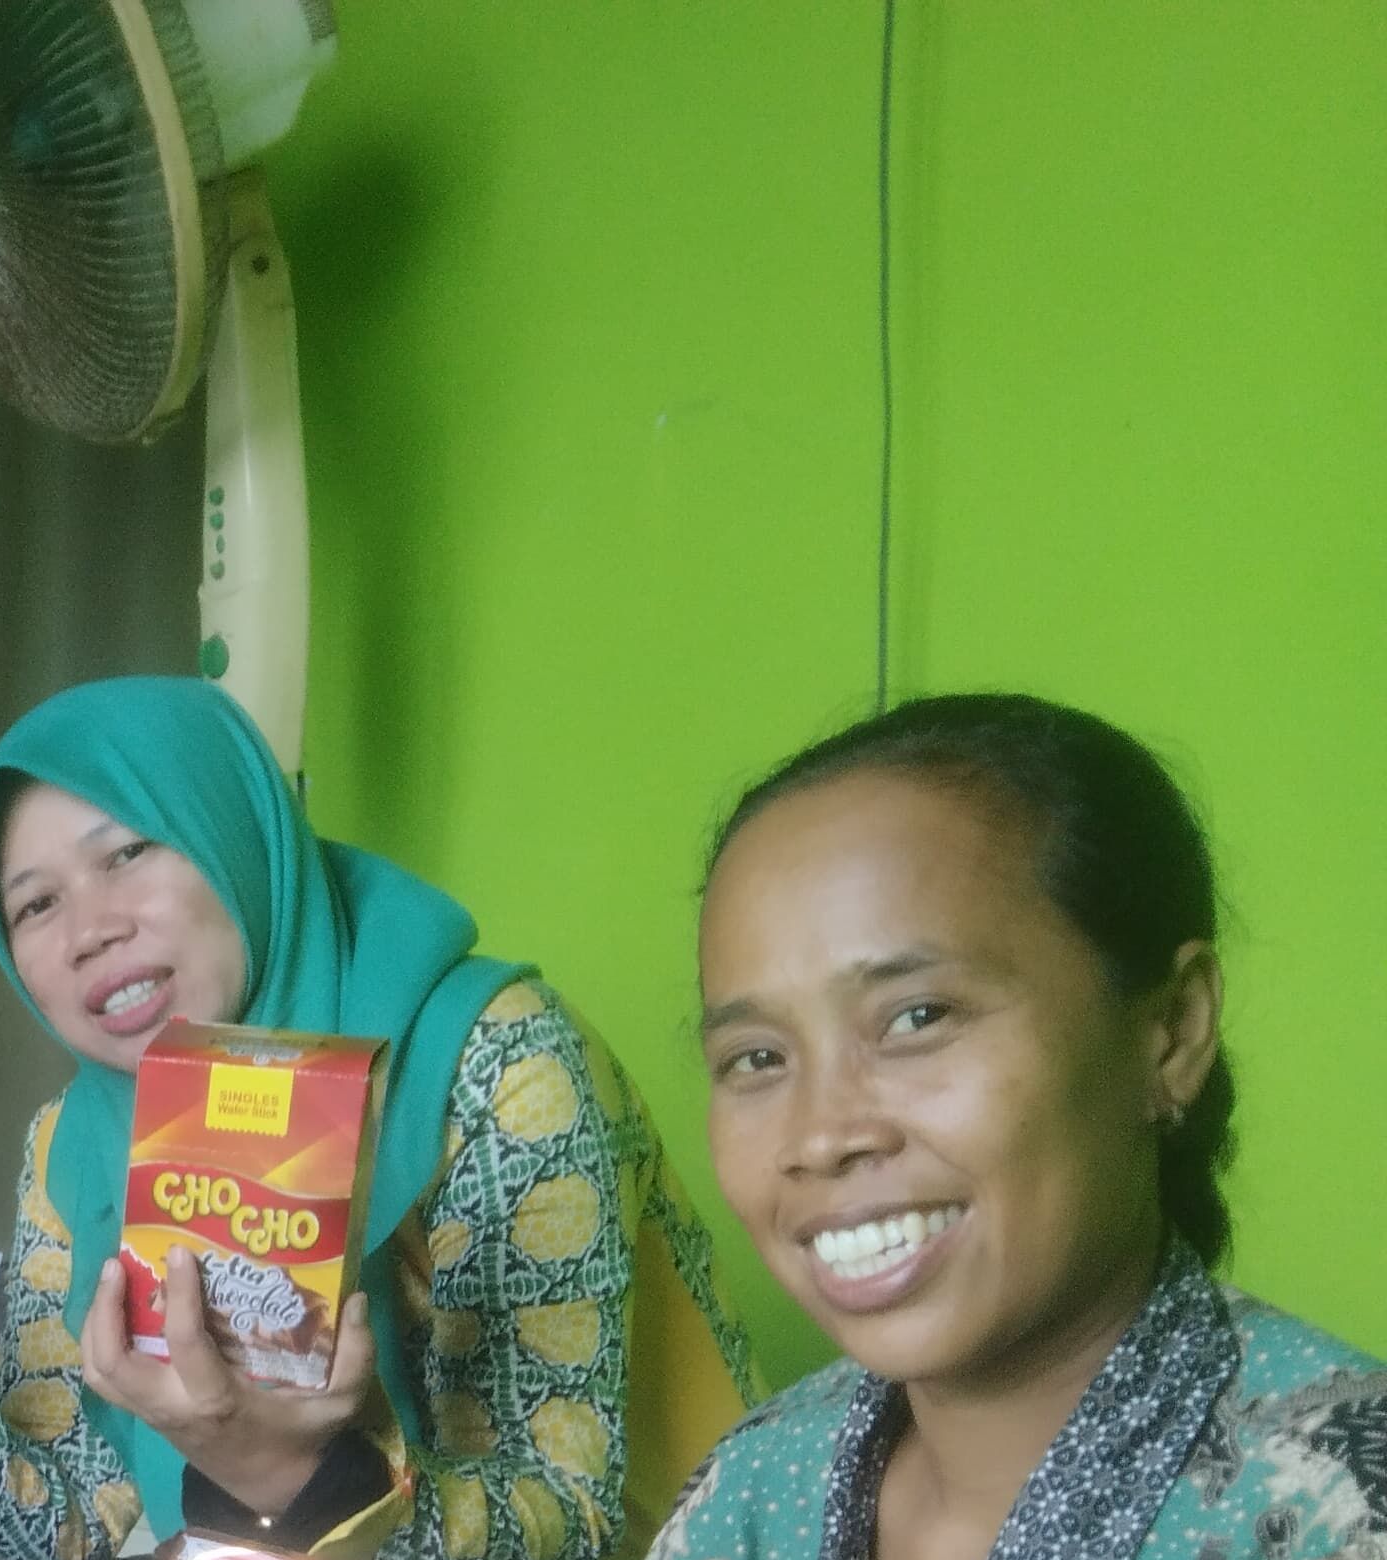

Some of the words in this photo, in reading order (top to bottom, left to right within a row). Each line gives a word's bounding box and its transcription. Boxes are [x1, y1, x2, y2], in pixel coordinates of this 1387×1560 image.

[219, 1090, 280, 1108] SINGLES
[218, 1102, 250, 1117] Wafer
[252, 1106, 278, 1120] Stick
[203, 1272, 304, 1330] hocolate
